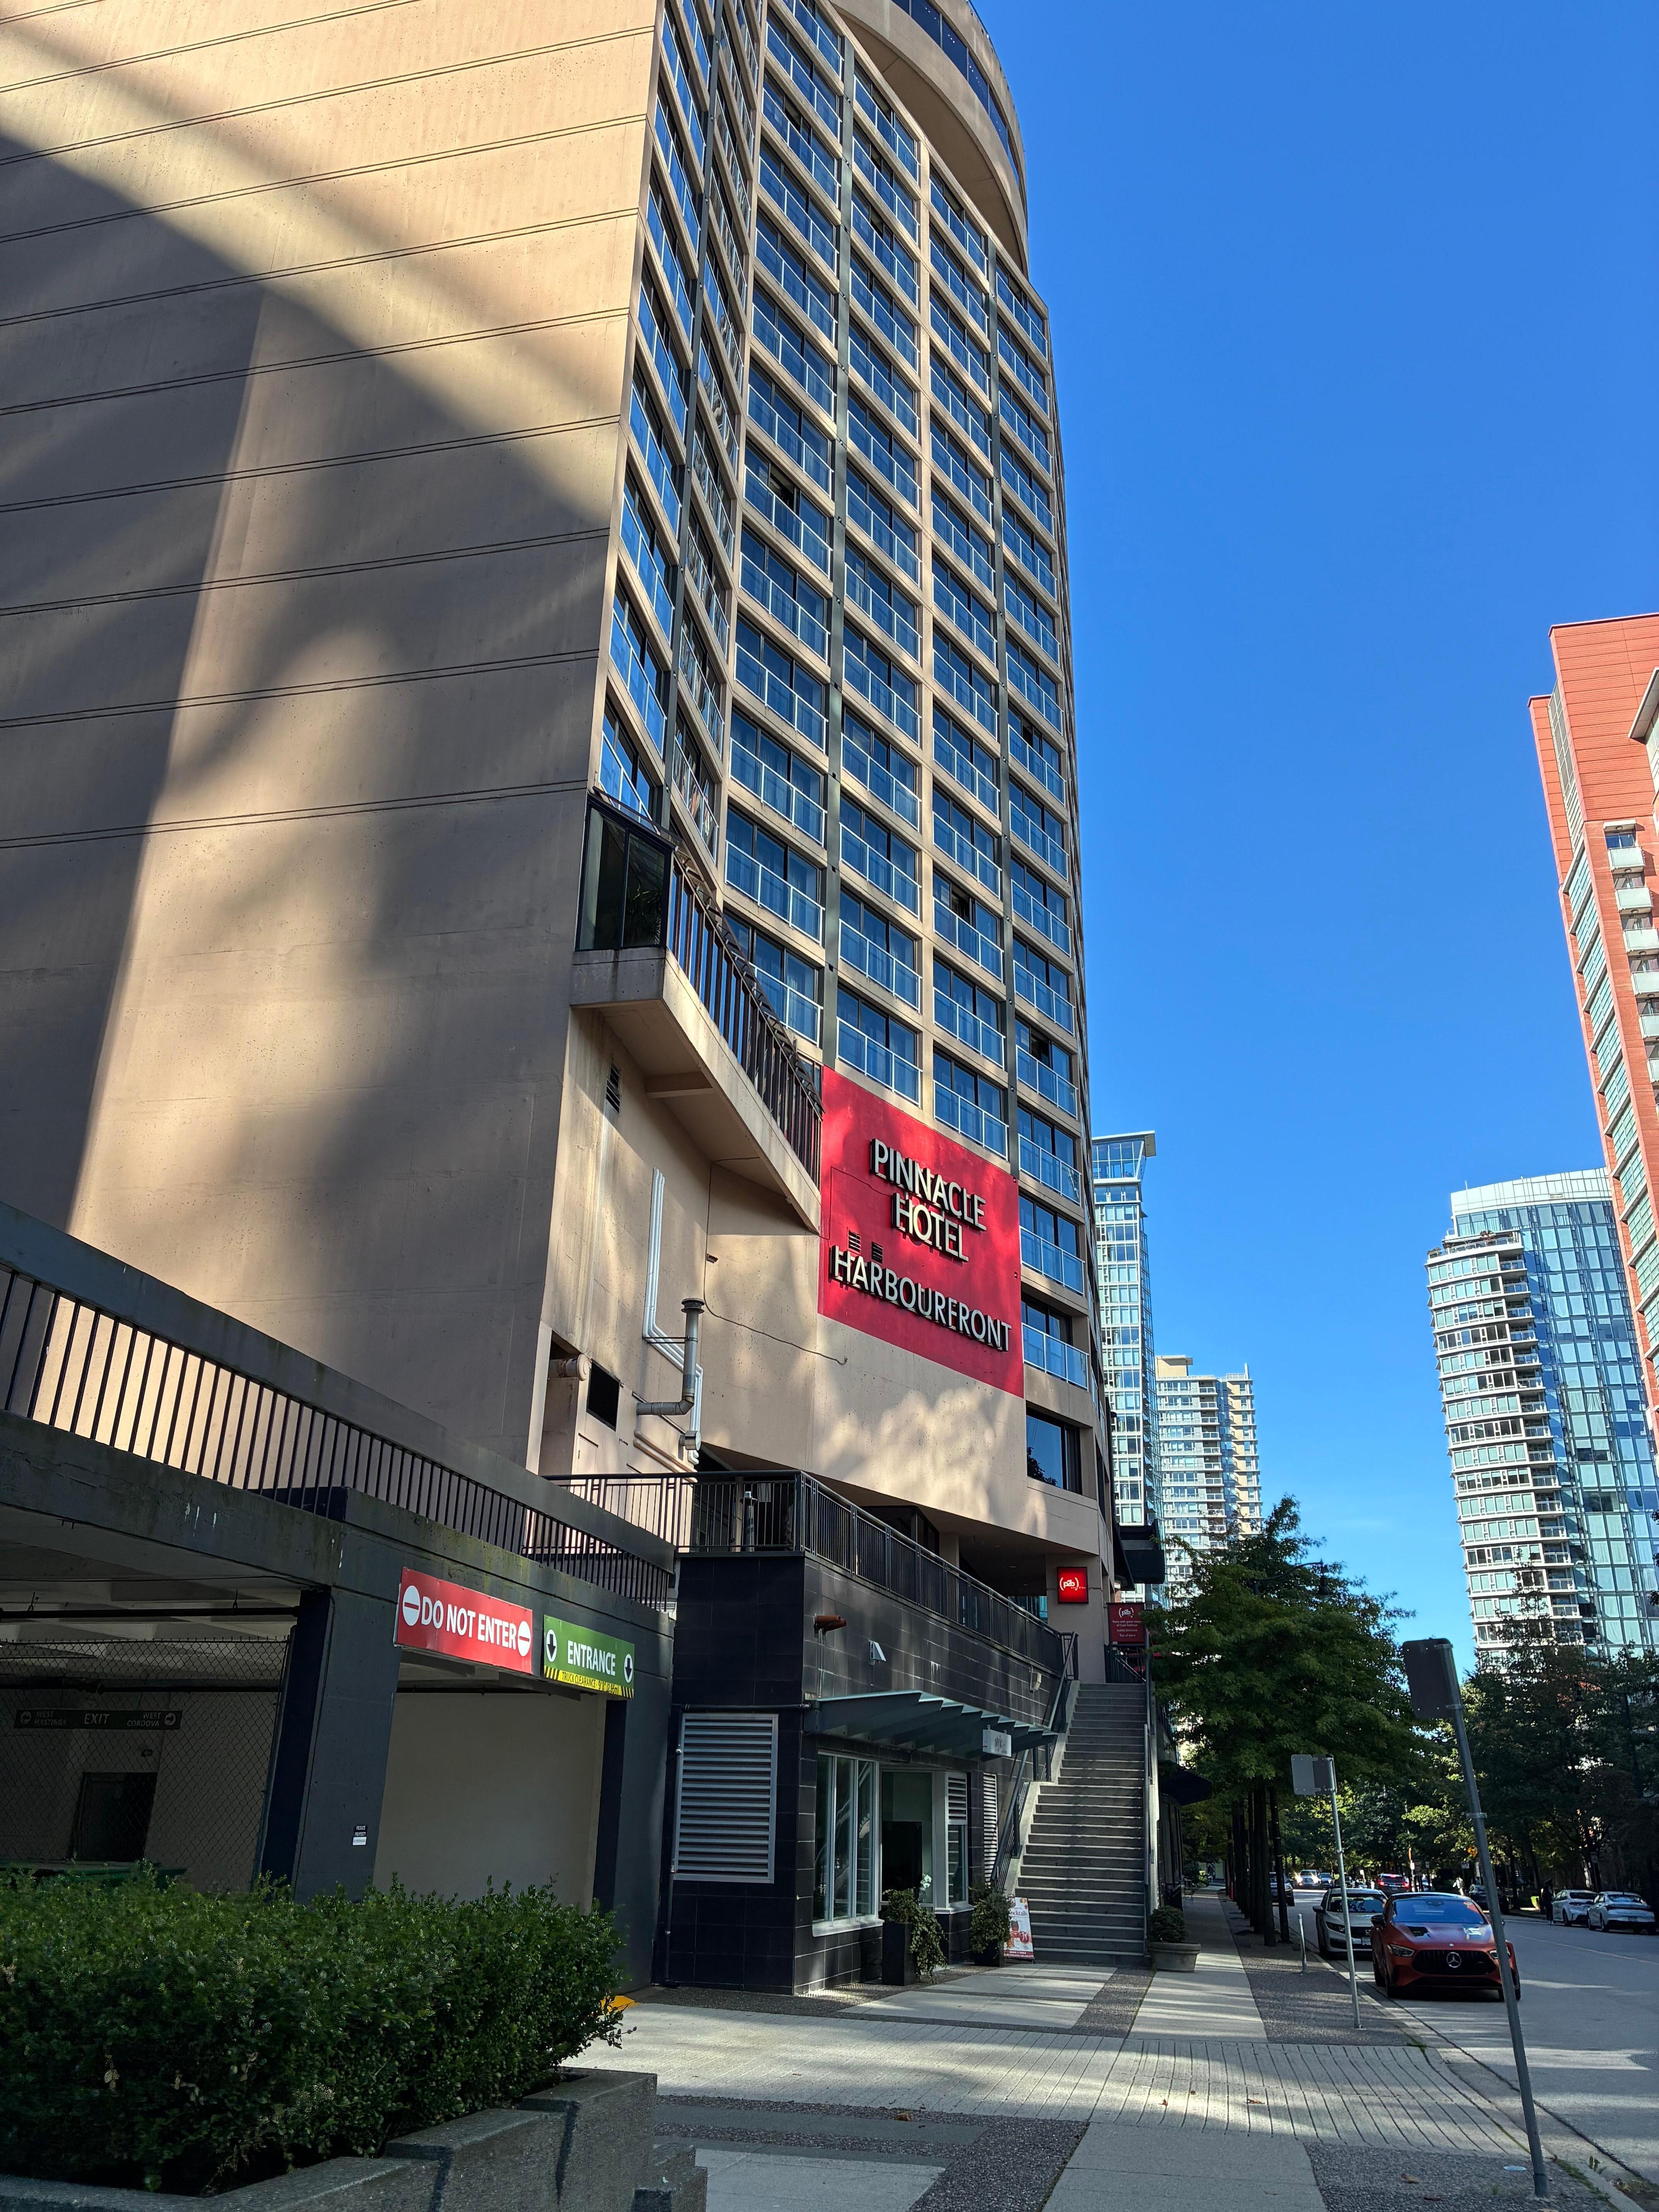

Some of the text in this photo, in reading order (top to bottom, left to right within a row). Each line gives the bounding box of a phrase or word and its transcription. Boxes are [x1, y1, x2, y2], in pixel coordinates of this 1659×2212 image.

[870, 1139, 987, 1231] PINNACLE
[891, 1193, 969, 1262] HOTEL
[830, 1245, 1013, 1352] HARBOURFRONT
[421, 1596, 517, 1650] DO NOT ENTER
[562, 1671, 574, 1683] TRUCK
[567, 1640, 616, 1676] ENTRANCE
[84, 1713, 110, 1724] EXIT
